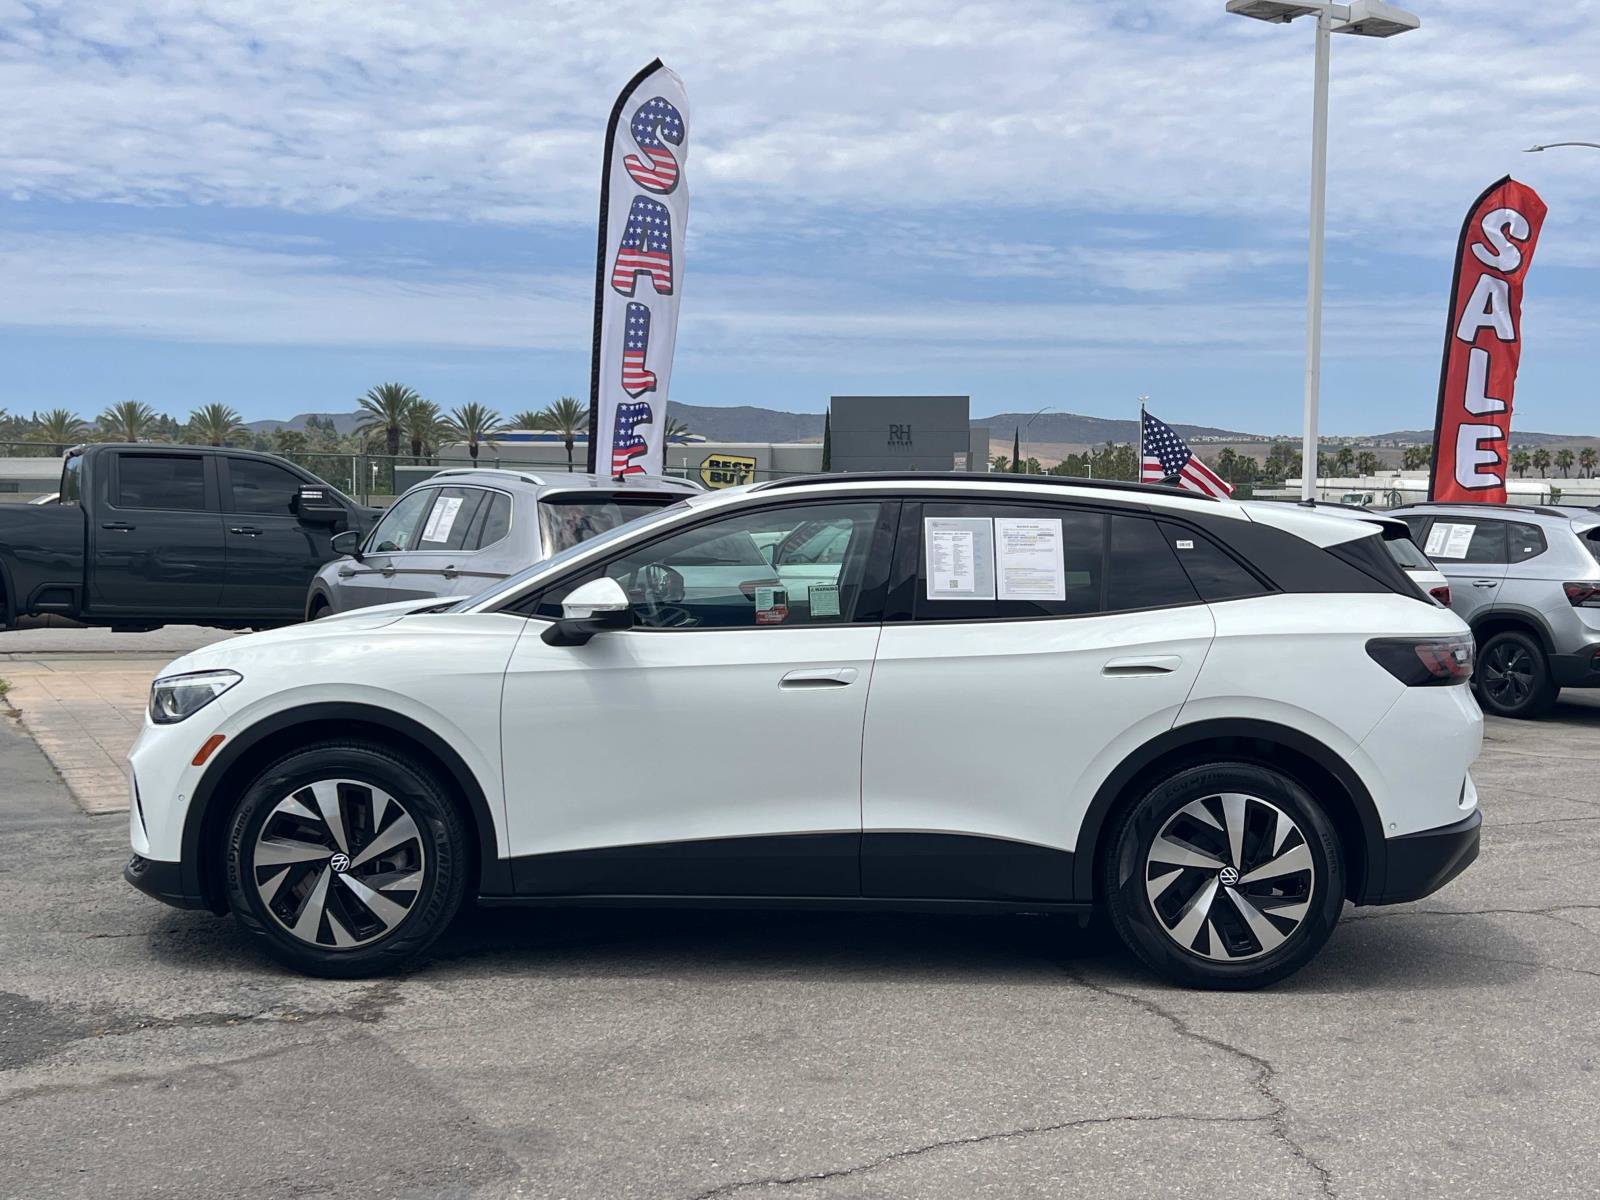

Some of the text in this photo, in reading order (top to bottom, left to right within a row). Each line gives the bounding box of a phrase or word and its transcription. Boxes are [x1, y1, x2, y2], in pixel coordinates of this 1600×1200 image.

[611, 95, 685, 476] SALE
[1454, 207, 1531, 490] SALE
[887, 423, 912, 441] RH
[708, 459, 753, 473] BEST
[710, 471, 748, 485] BUY
